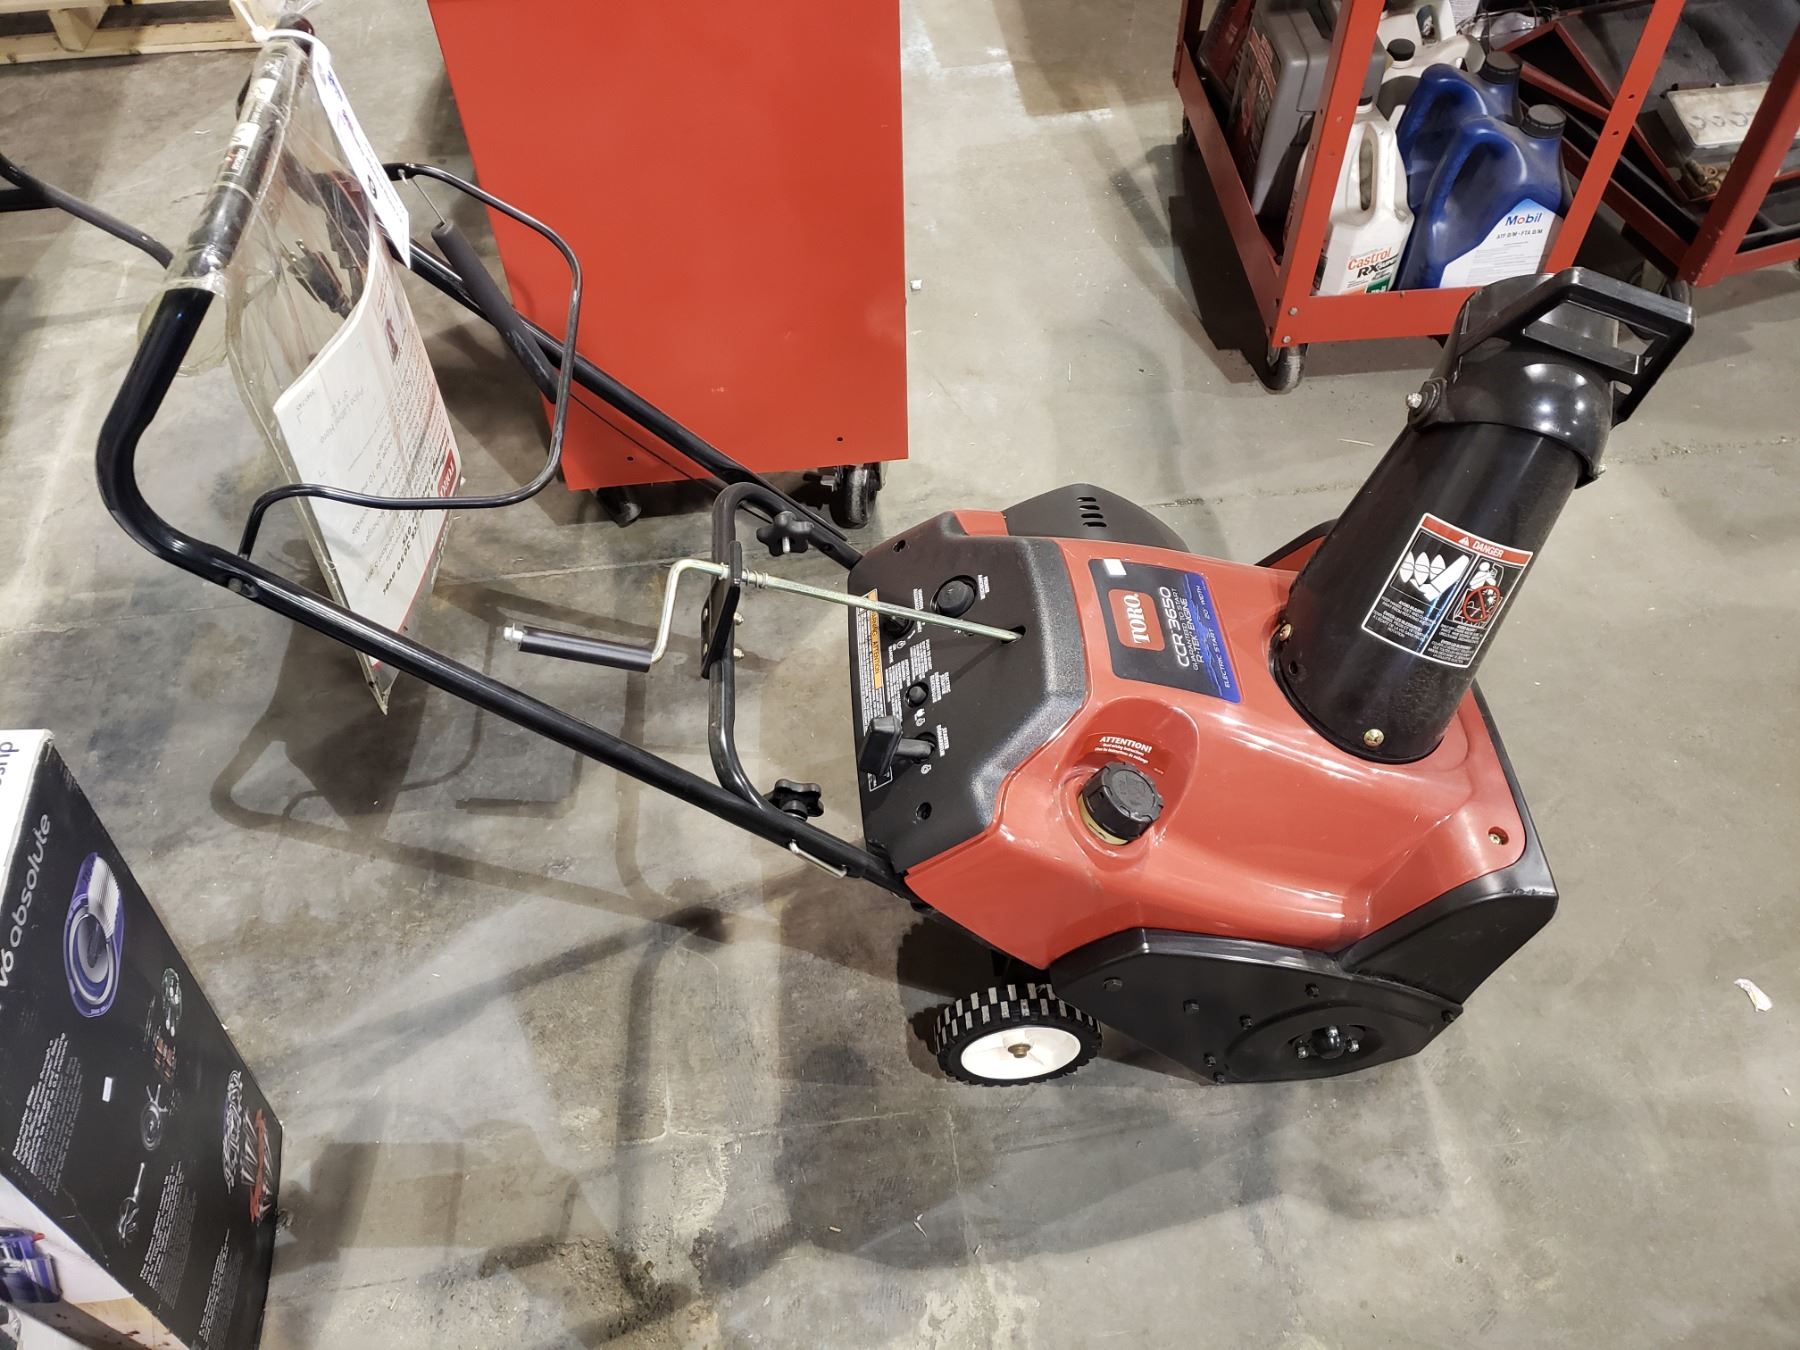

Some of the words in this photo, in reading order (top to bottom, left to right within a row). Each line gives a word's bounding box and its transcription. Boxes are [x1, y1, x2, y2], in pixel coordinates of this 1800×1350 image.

[1505, 212, 1543, 226] Mobil
[1348, 246, 1392, 270] Castrol
[1472, 540, 1504, 558] DANGER
[1124, 594, 1151, 644] TORO
[1159, 586, 1181, 632] 3650
[1172, 632, 1190, 668] CCR
[1099, 736, 1152, 753] ATTENTION!
[10, 814, 50, 948] absolute
